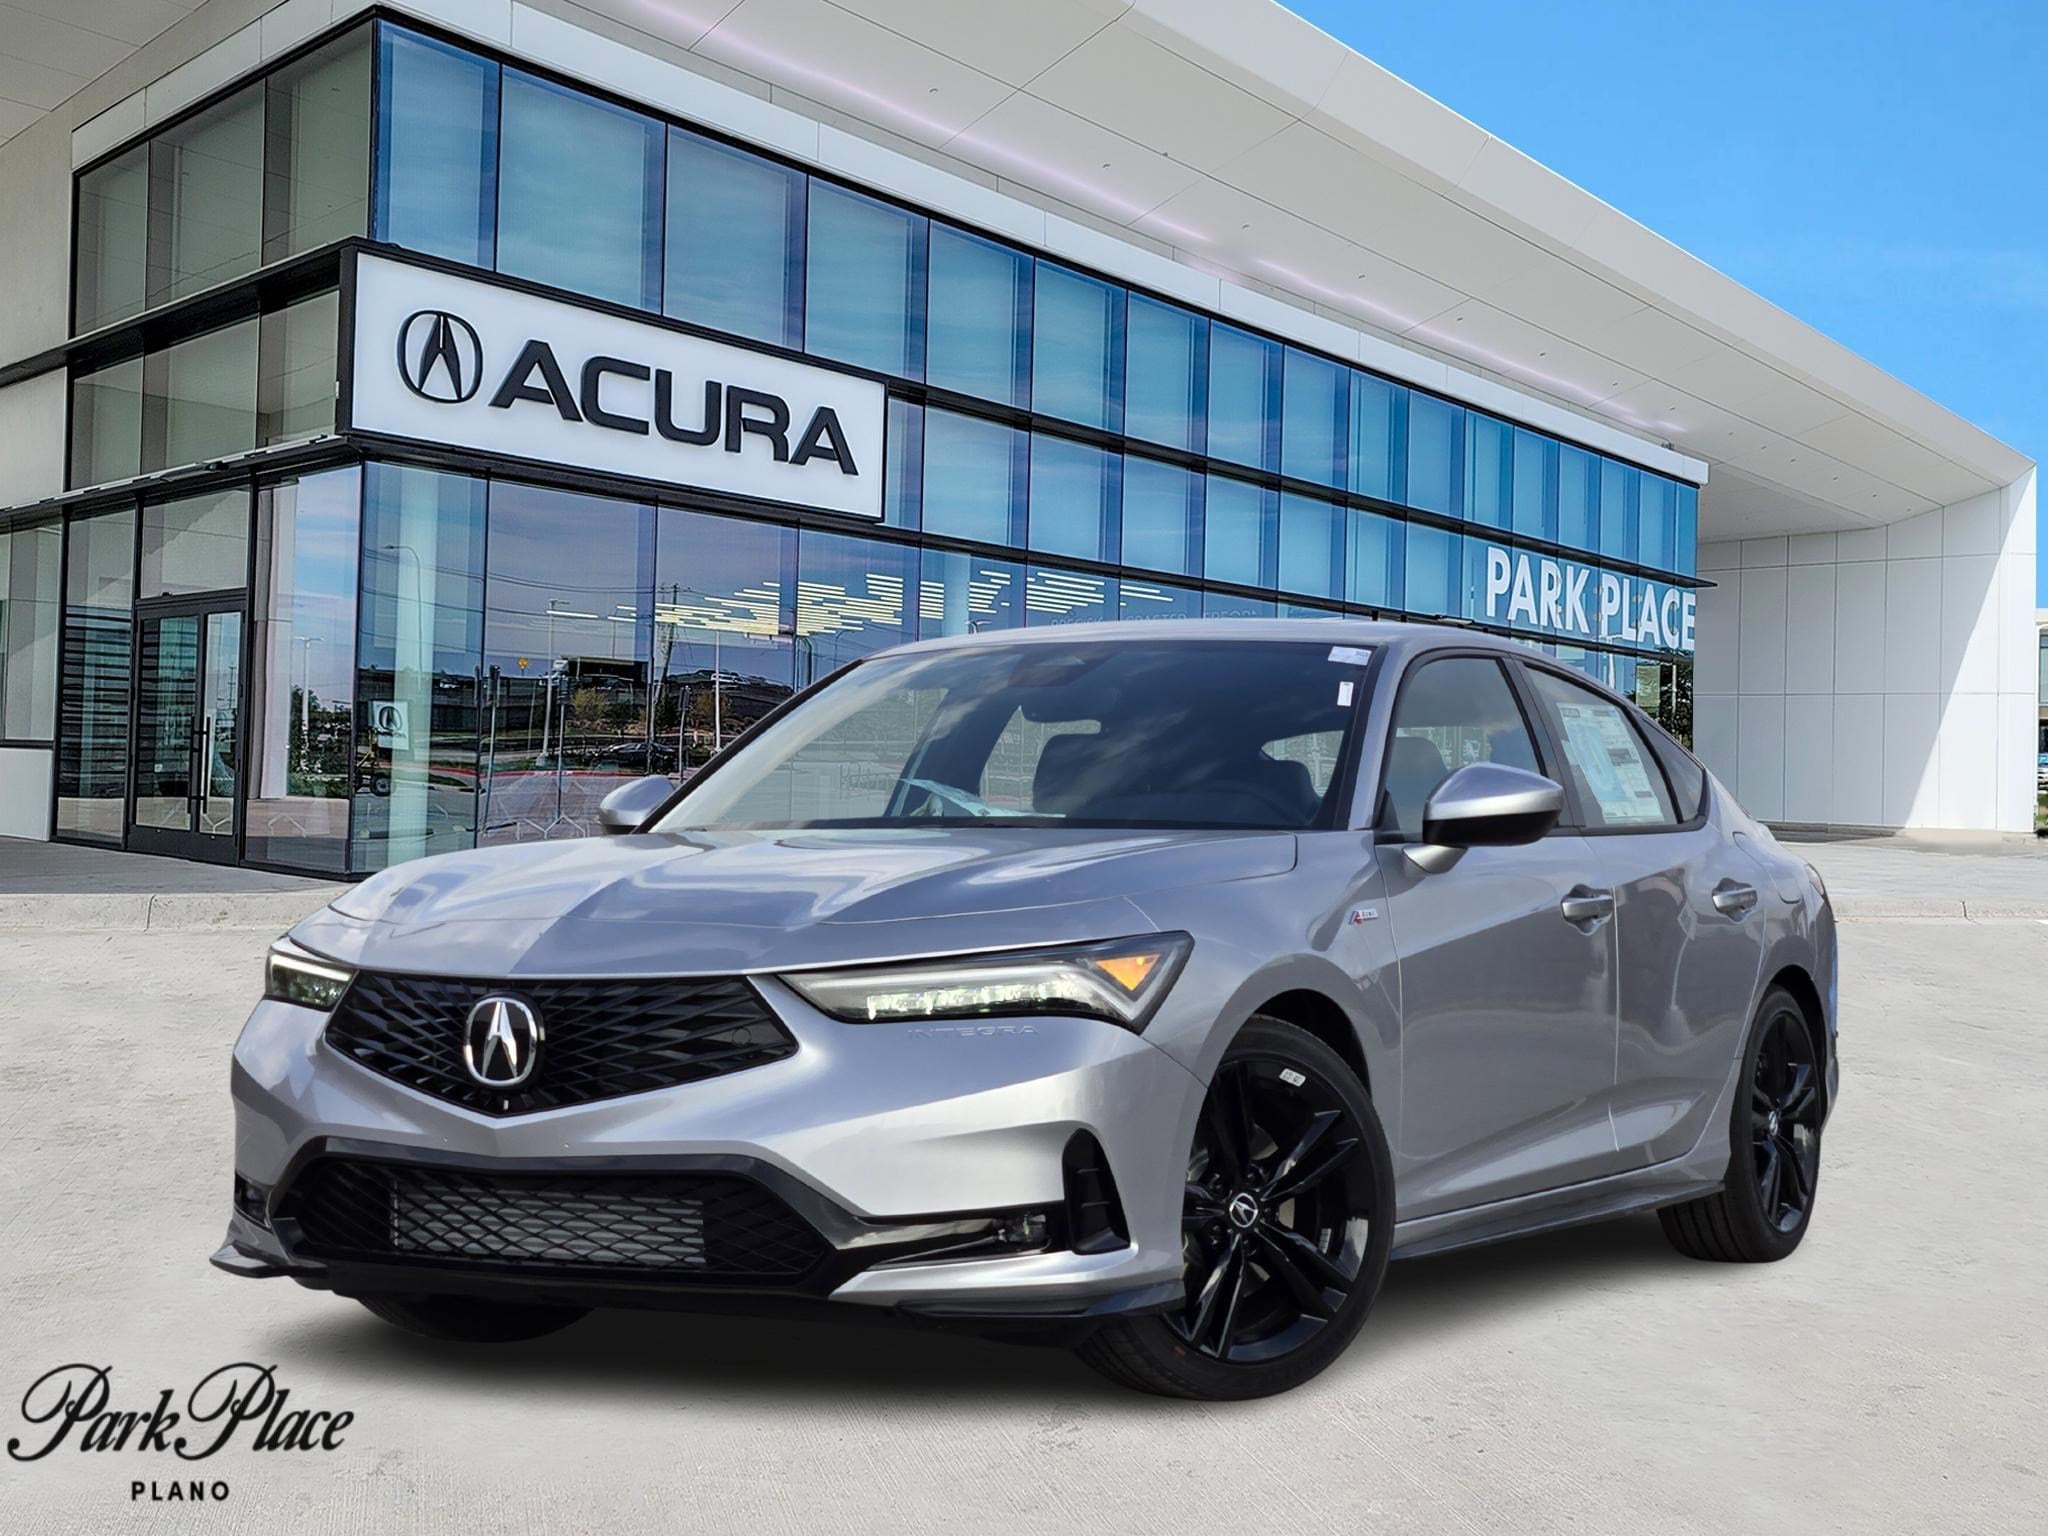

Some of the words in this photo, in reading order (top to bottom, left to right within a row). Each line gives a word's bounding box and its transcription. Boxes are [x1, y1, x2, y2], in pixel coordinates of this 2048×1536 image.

[488, 339, 859, 476] ACURA
[1486, 547, 1591, 634] PARK
[1600, 573, 1697, 650] PLACE
